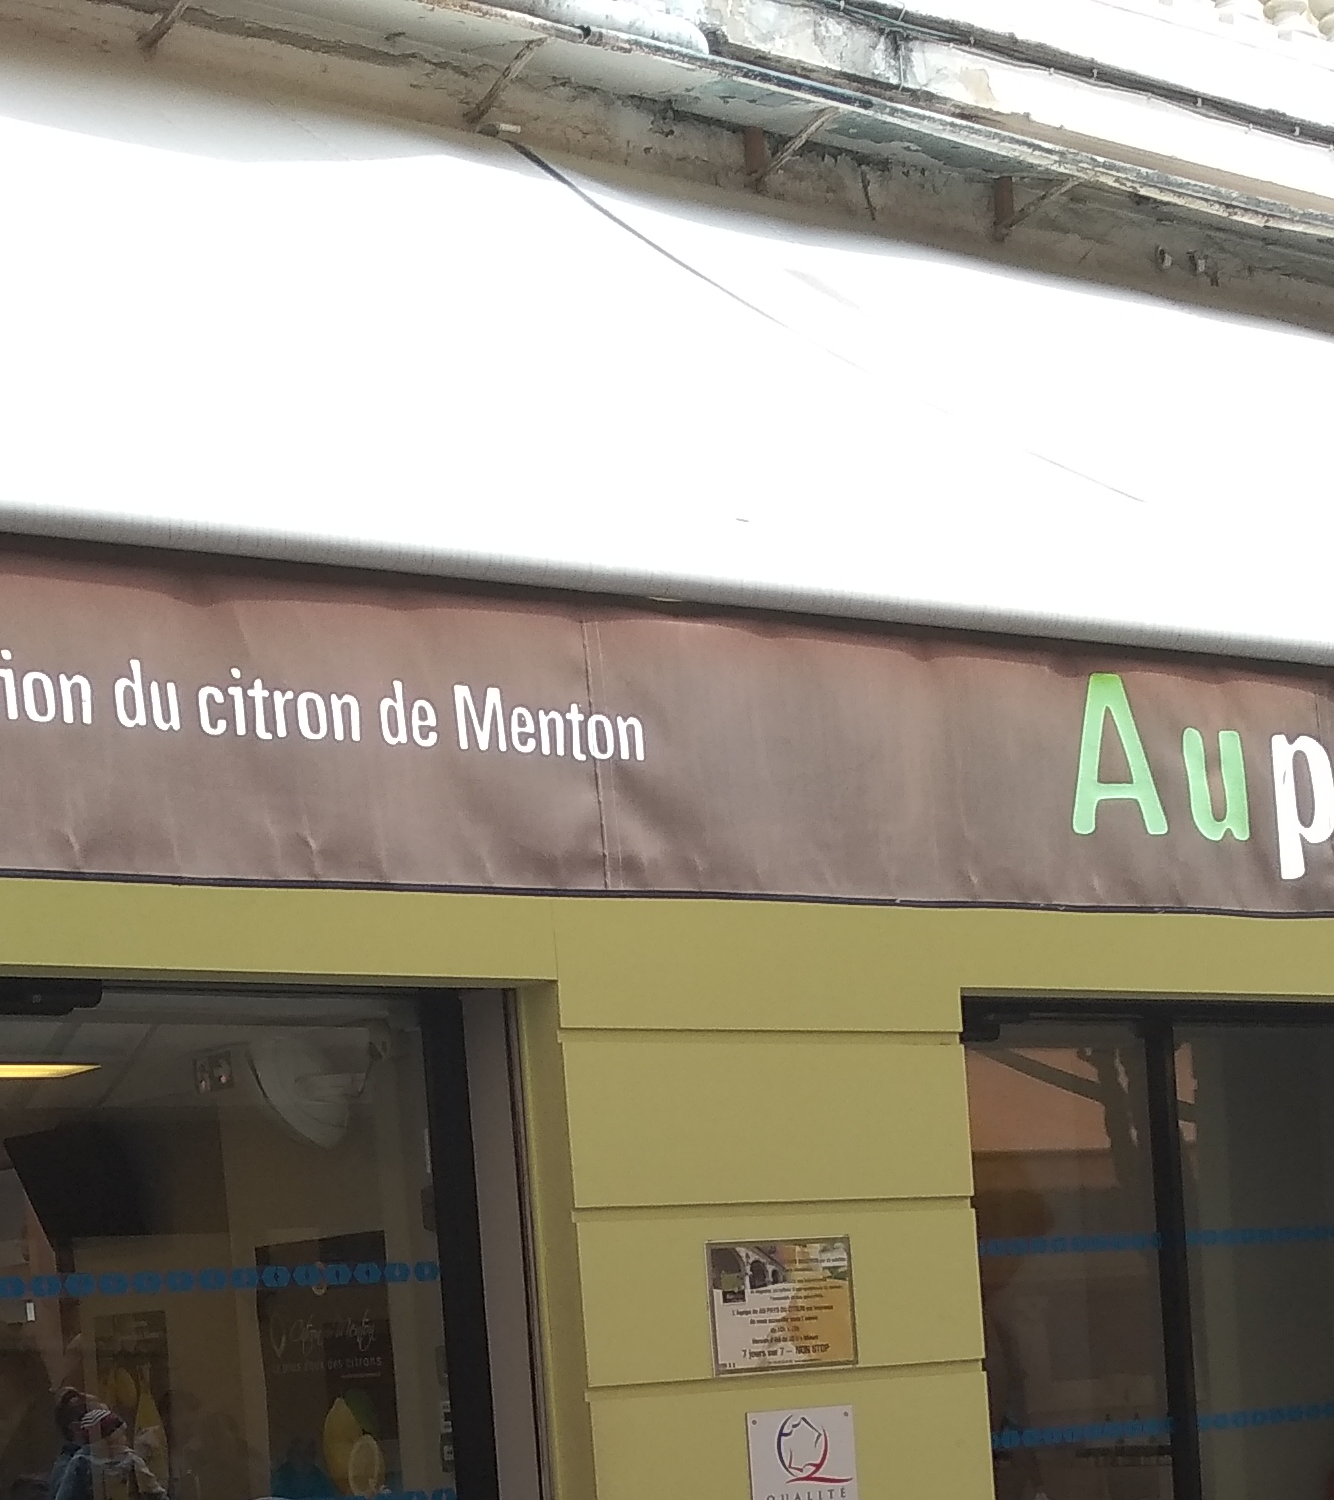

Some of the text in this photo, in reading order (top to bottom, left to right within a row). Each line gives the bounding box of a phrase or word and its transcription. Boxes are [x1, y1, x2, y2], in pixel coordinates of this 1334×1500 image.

[115, 658, 182, 732] du
[198, 665, 363, 743] citron
[378, 679, 439, 748] de
[454, 683, 647, 763] Menton
